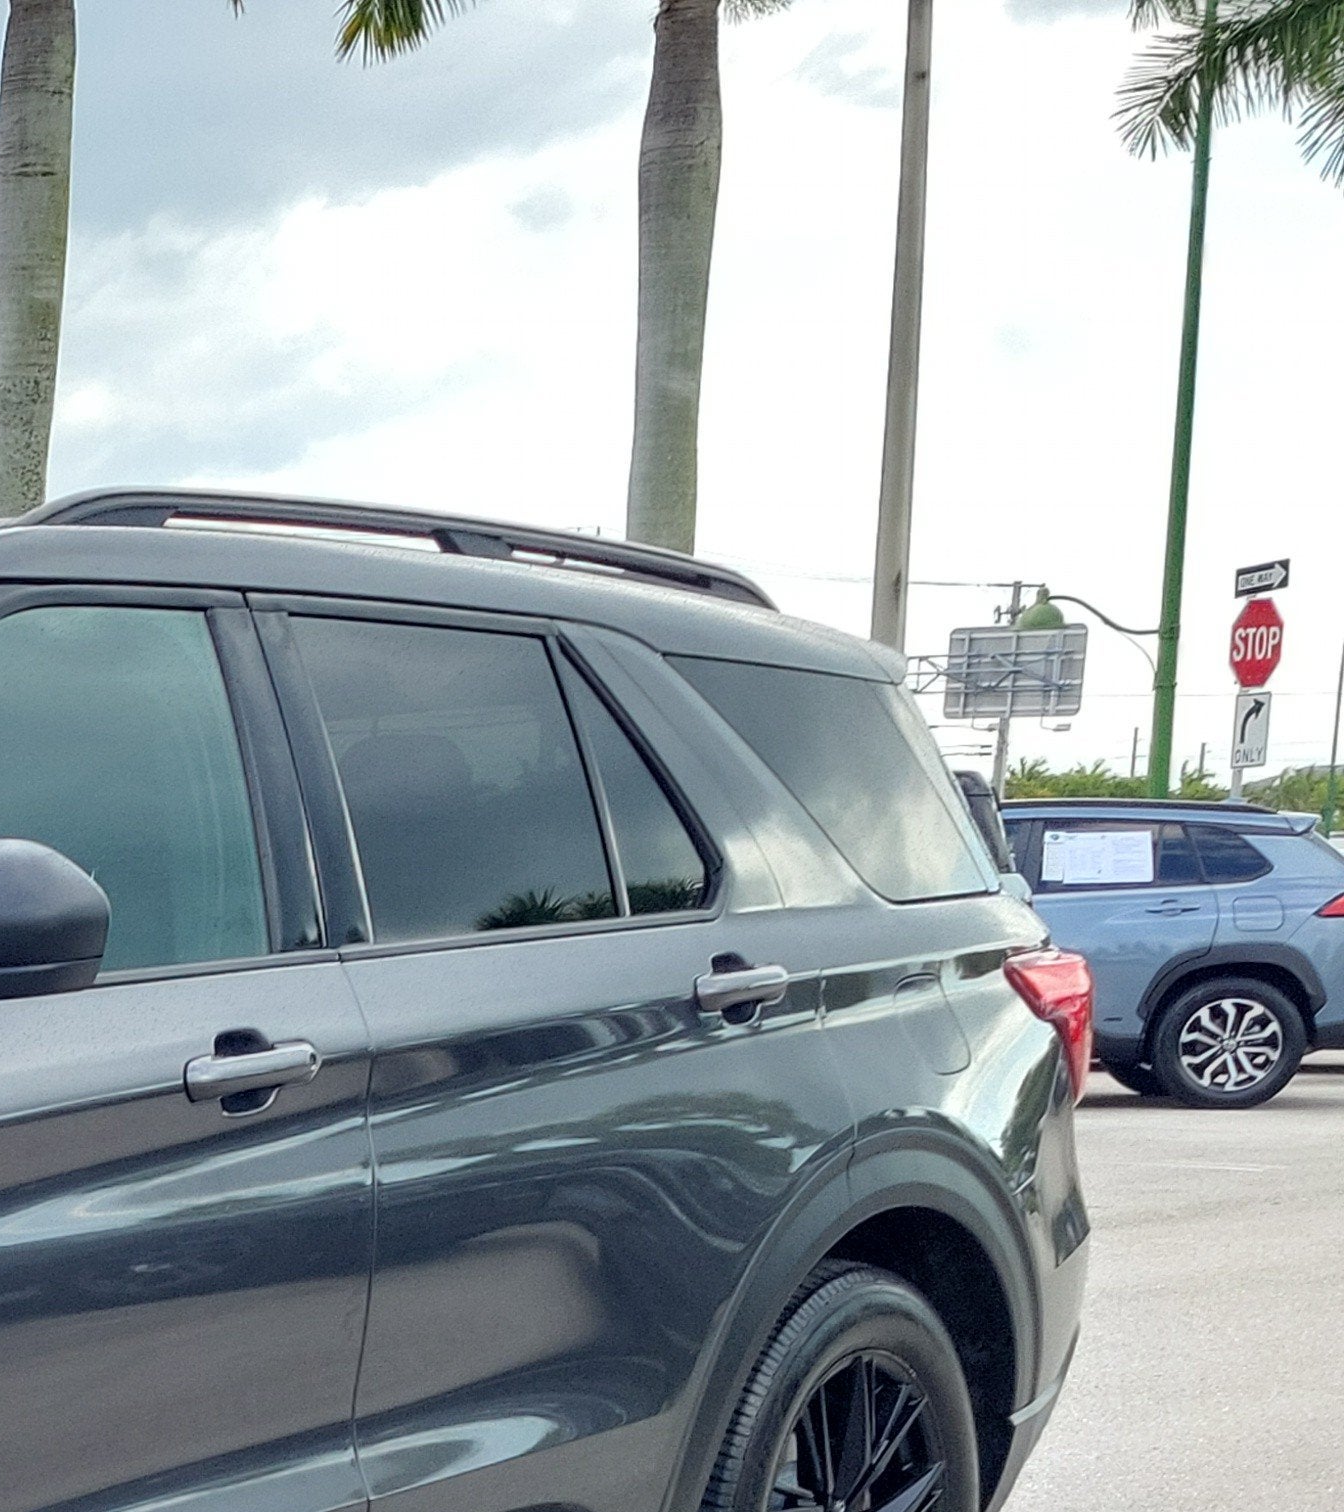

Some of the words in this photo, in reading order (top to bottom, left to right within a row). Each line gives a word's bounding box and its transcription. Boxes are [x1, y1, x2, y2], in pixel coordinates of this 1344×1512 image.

[1240, 574, 1256, 588] ONE
[1232, 624, 1282, 662] STOP
[1234, 746, 1265, 765] ONLY
